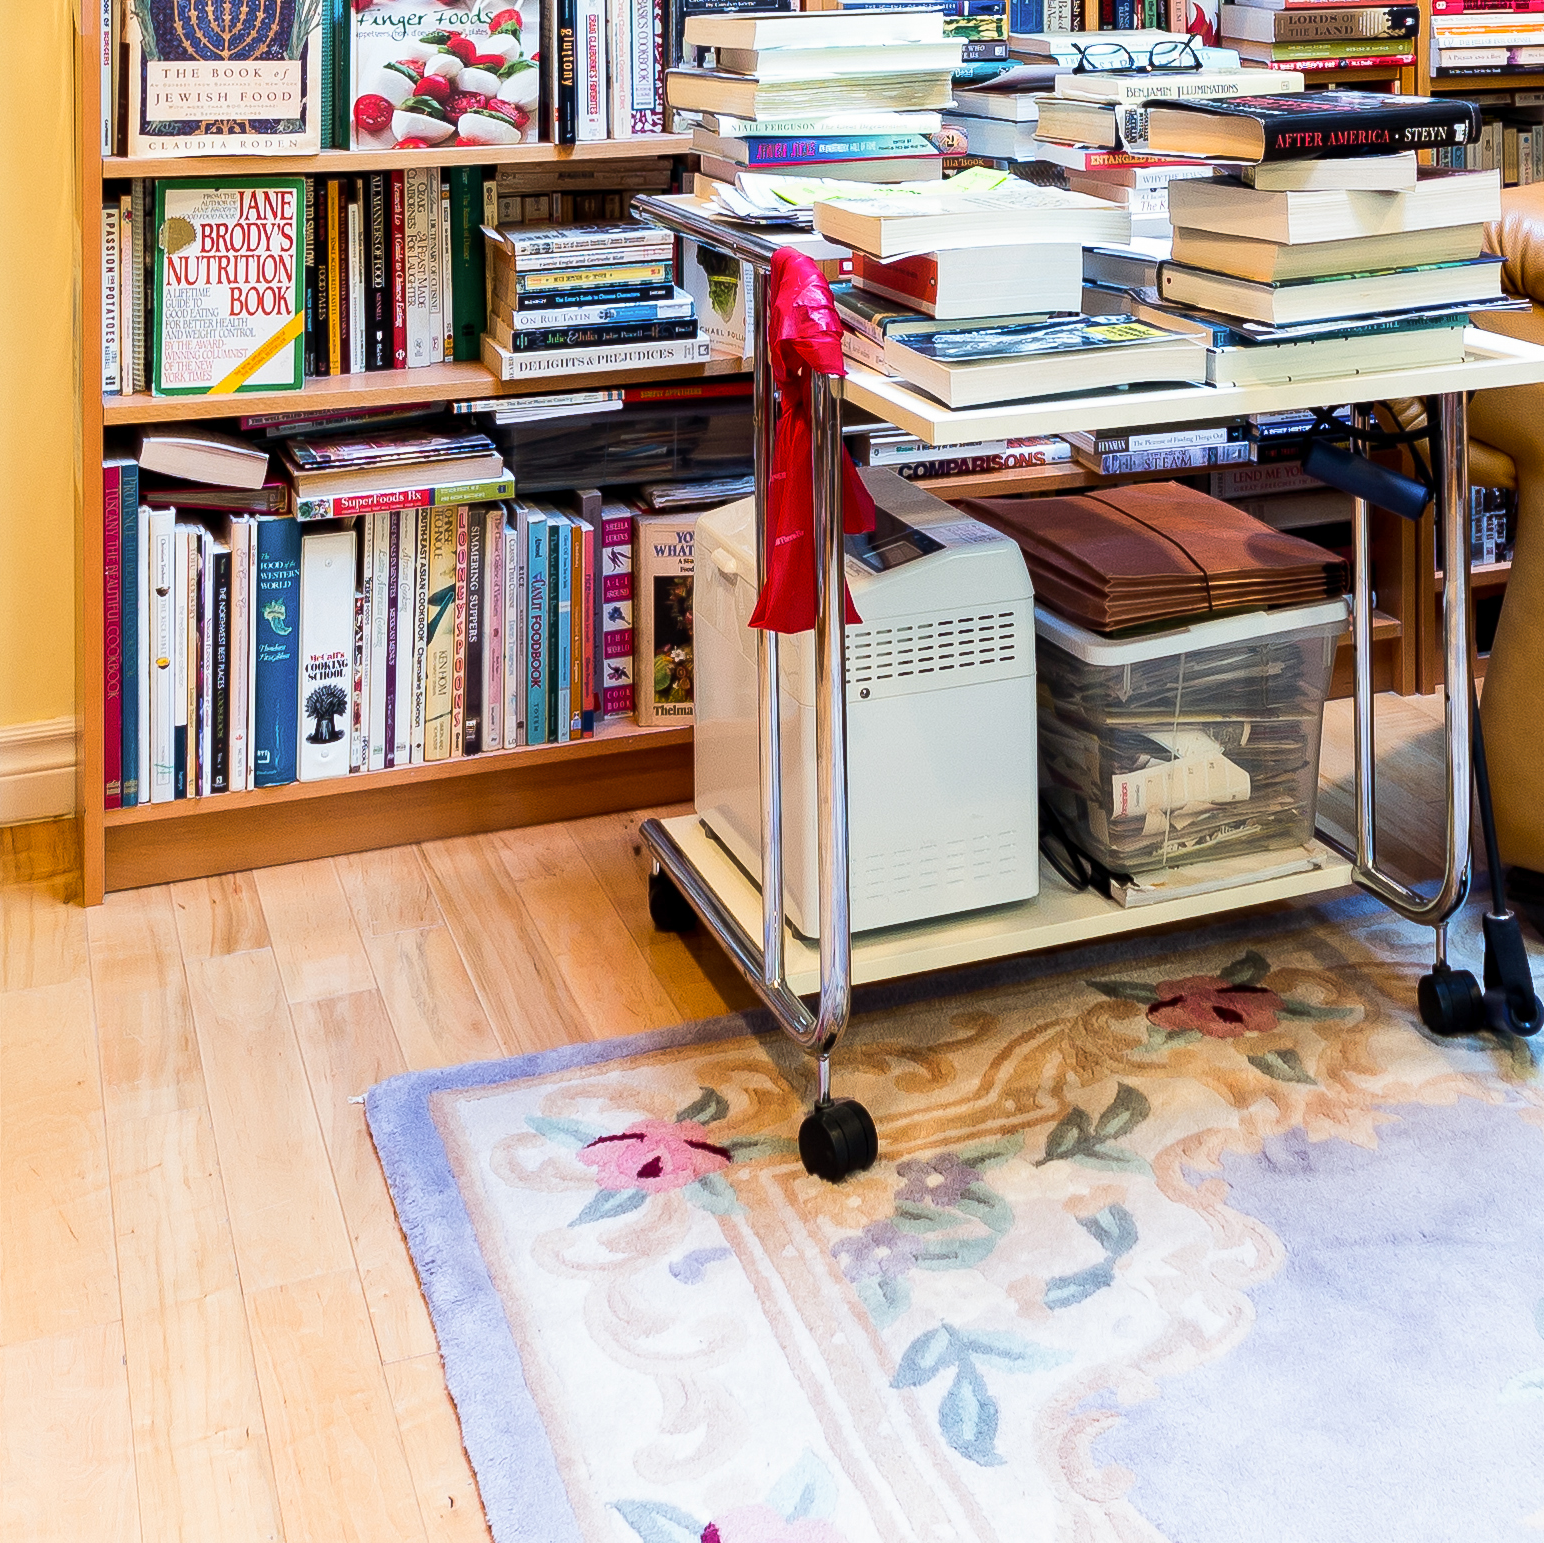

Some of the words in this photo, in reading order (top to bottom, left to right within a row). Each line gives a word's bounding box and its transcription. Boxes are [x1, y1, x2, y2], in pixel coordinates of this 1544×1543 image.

[161, 68, 200, 79] THE
[211, 68, 263, 79] BOOK
[154, 92, 229, 105] JEWISH
[240, 91, 293, 102] FOOD
[1125, 83, 1174, 100] BENJAMIN
[1179, 82, 1240, 98] ILLUMINATIONS
[148, 140, 228, 151] CLAUDIA
[239, 139, 299, 150] RODEN
[1275, 133, 1322, 151] AFTER
[1328, 128, 1390, 146] AMERICA
[1404, 125, 1449, 144] STEYN
[236, 190, 294, 221] JANE
[200, 221, 294, 252] BRODY'S
[164, 254, 294, 285] NUTRITION
[228, 284, 293, 316] BOOK
[897, 448, 1047, 479] COMPARISONS
[340, 491, 406, 508] SuperFoods
